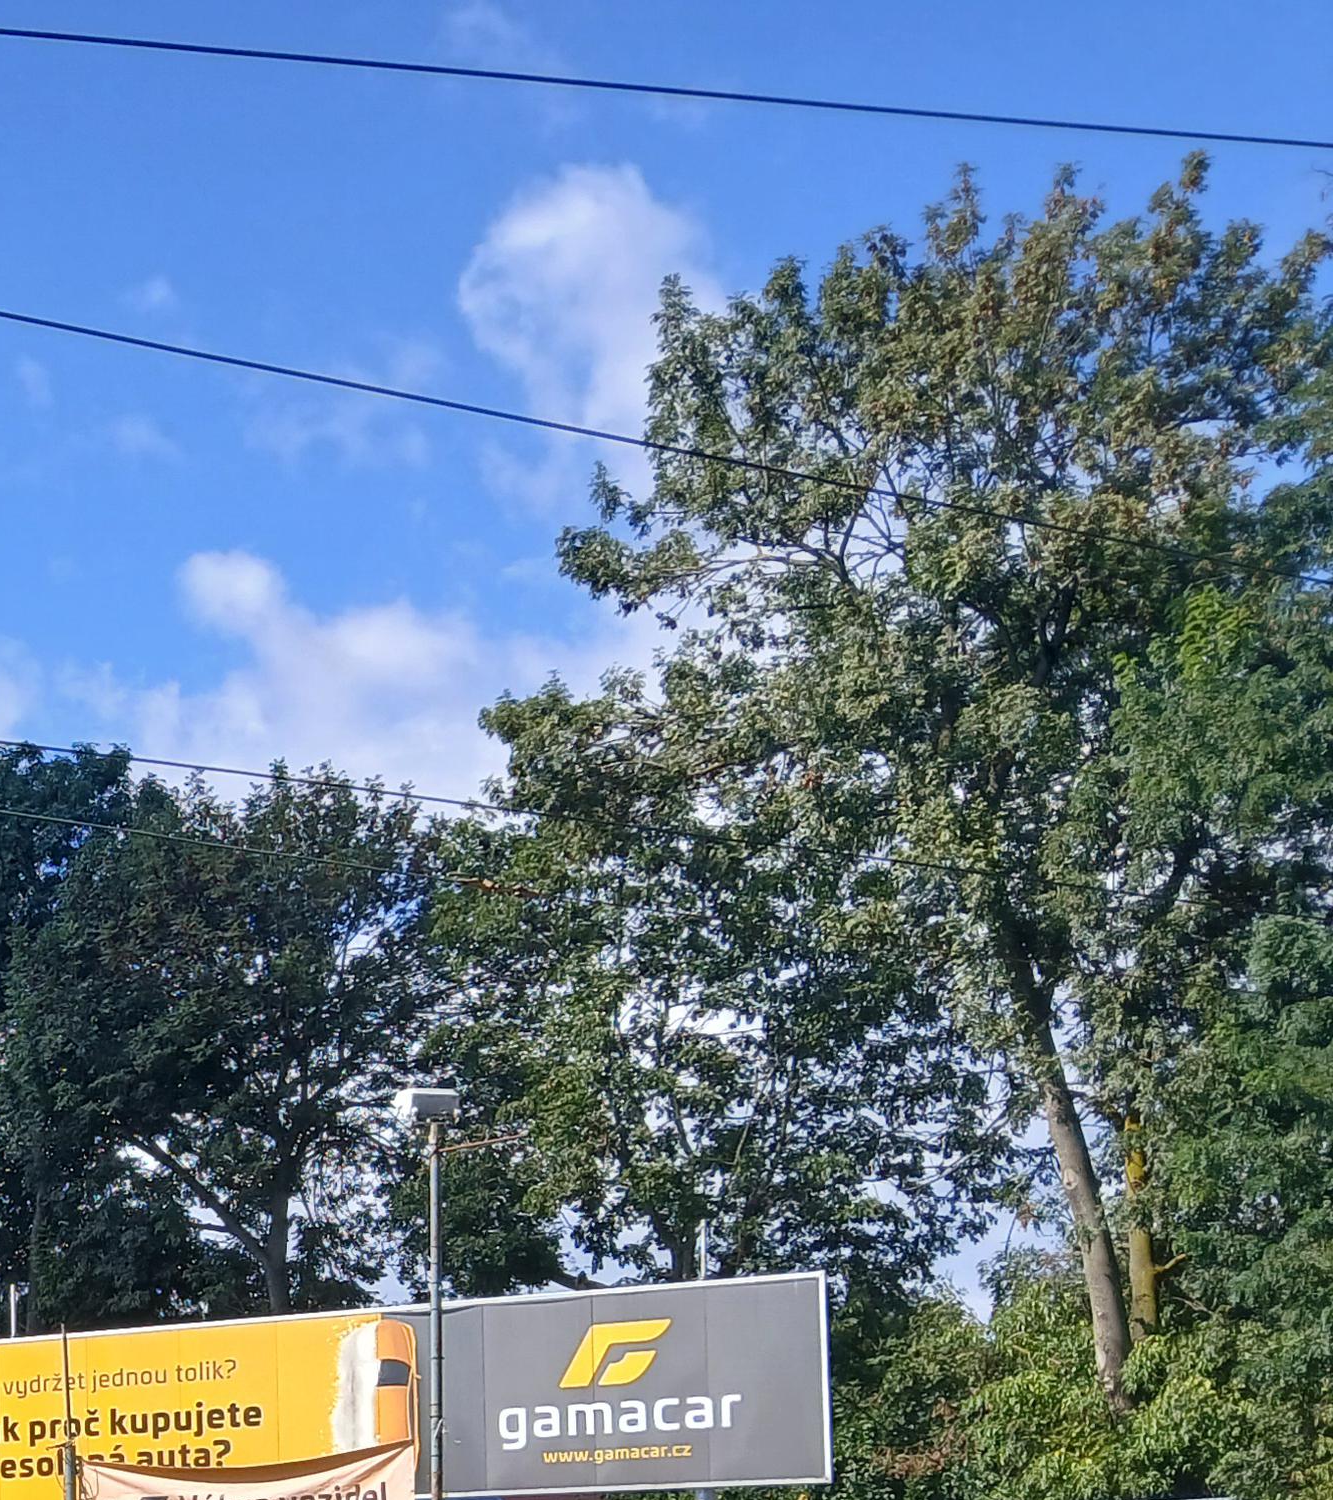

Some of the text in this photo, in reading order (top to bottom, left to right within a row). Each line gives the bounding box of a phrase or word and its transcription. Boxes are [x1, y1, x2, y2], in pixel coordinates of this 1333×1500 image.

[3, 1373, 86, 1399] vydržet
[91, 1368, 167, 1393] jednou
[176, 1359, 237, 1383] tolik?
[29, 1409, 100, 1447] proč
[110, 1401, 262, 1439] kupujete
[498, 1394, 742, 1450] gamacar
[137, 1440, 231, 1468] auta?
[543, 1444, 693, 1465] www.gamacar.cz
